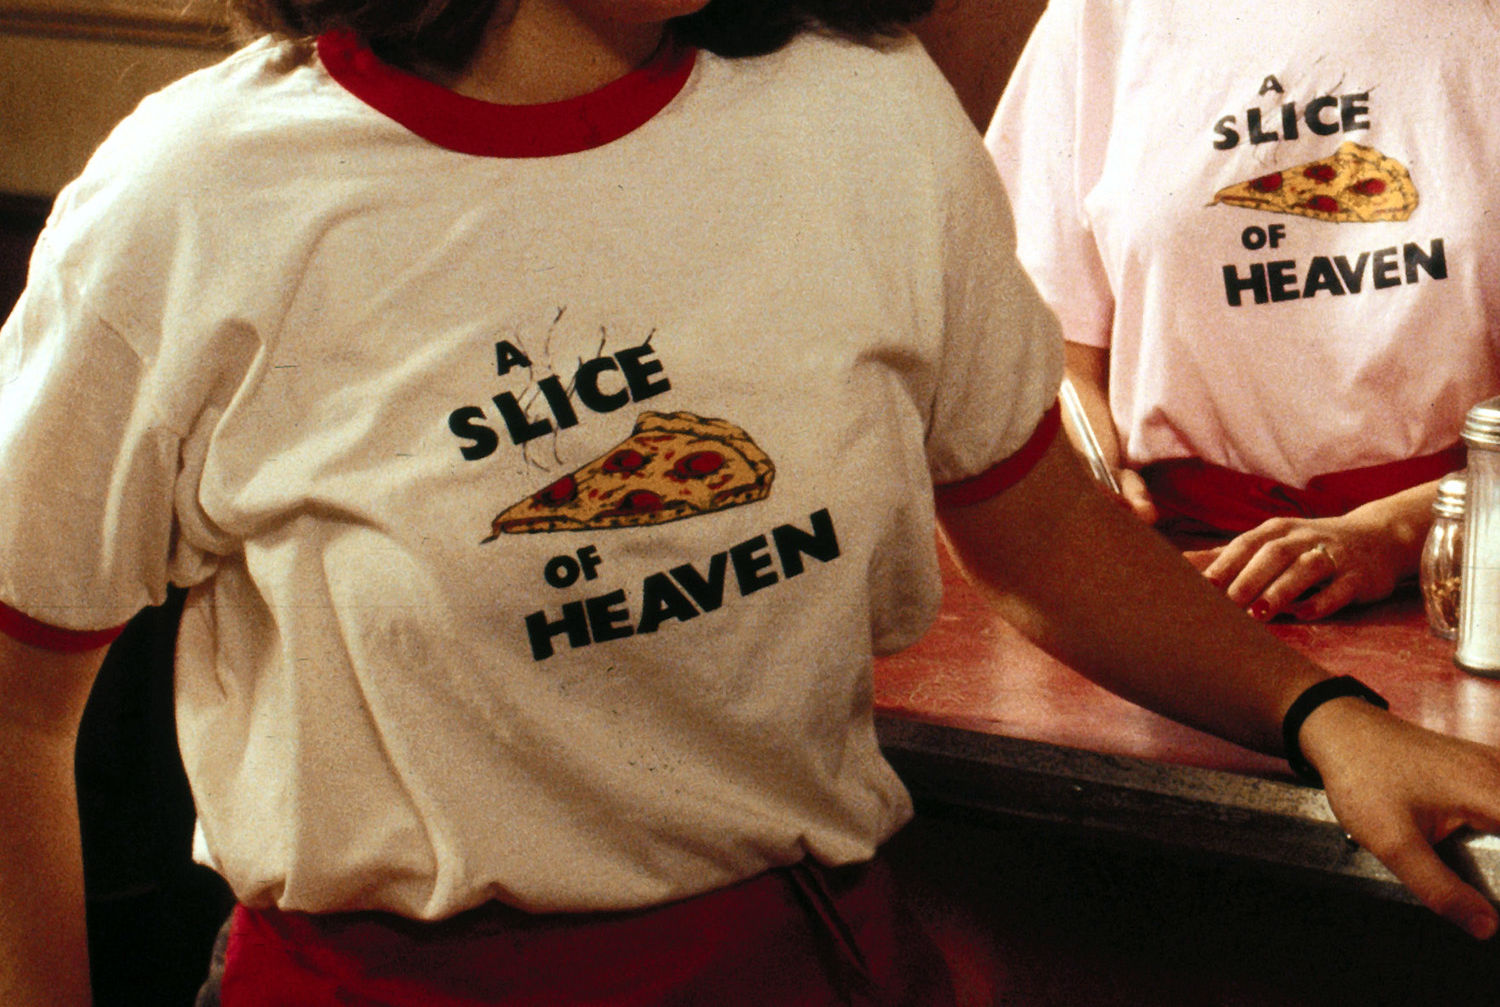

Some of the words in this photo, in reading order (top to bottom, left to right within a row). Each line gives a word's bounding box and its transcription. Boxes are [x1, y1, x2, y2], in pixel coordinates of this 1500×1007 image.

[1258, 74, 1284, 96] A
[1213, 92, 1371, 150] SLICE
[1241, 224, 1286, 250] OF
[1222, 238, 1448, 307] HEAVEN
[494, 339, 532, 376] A
[448, 343, 671, 461] SLICE
[524, 507, 840, 661] HEAVEN
[544, 544, 603, 589] OF
